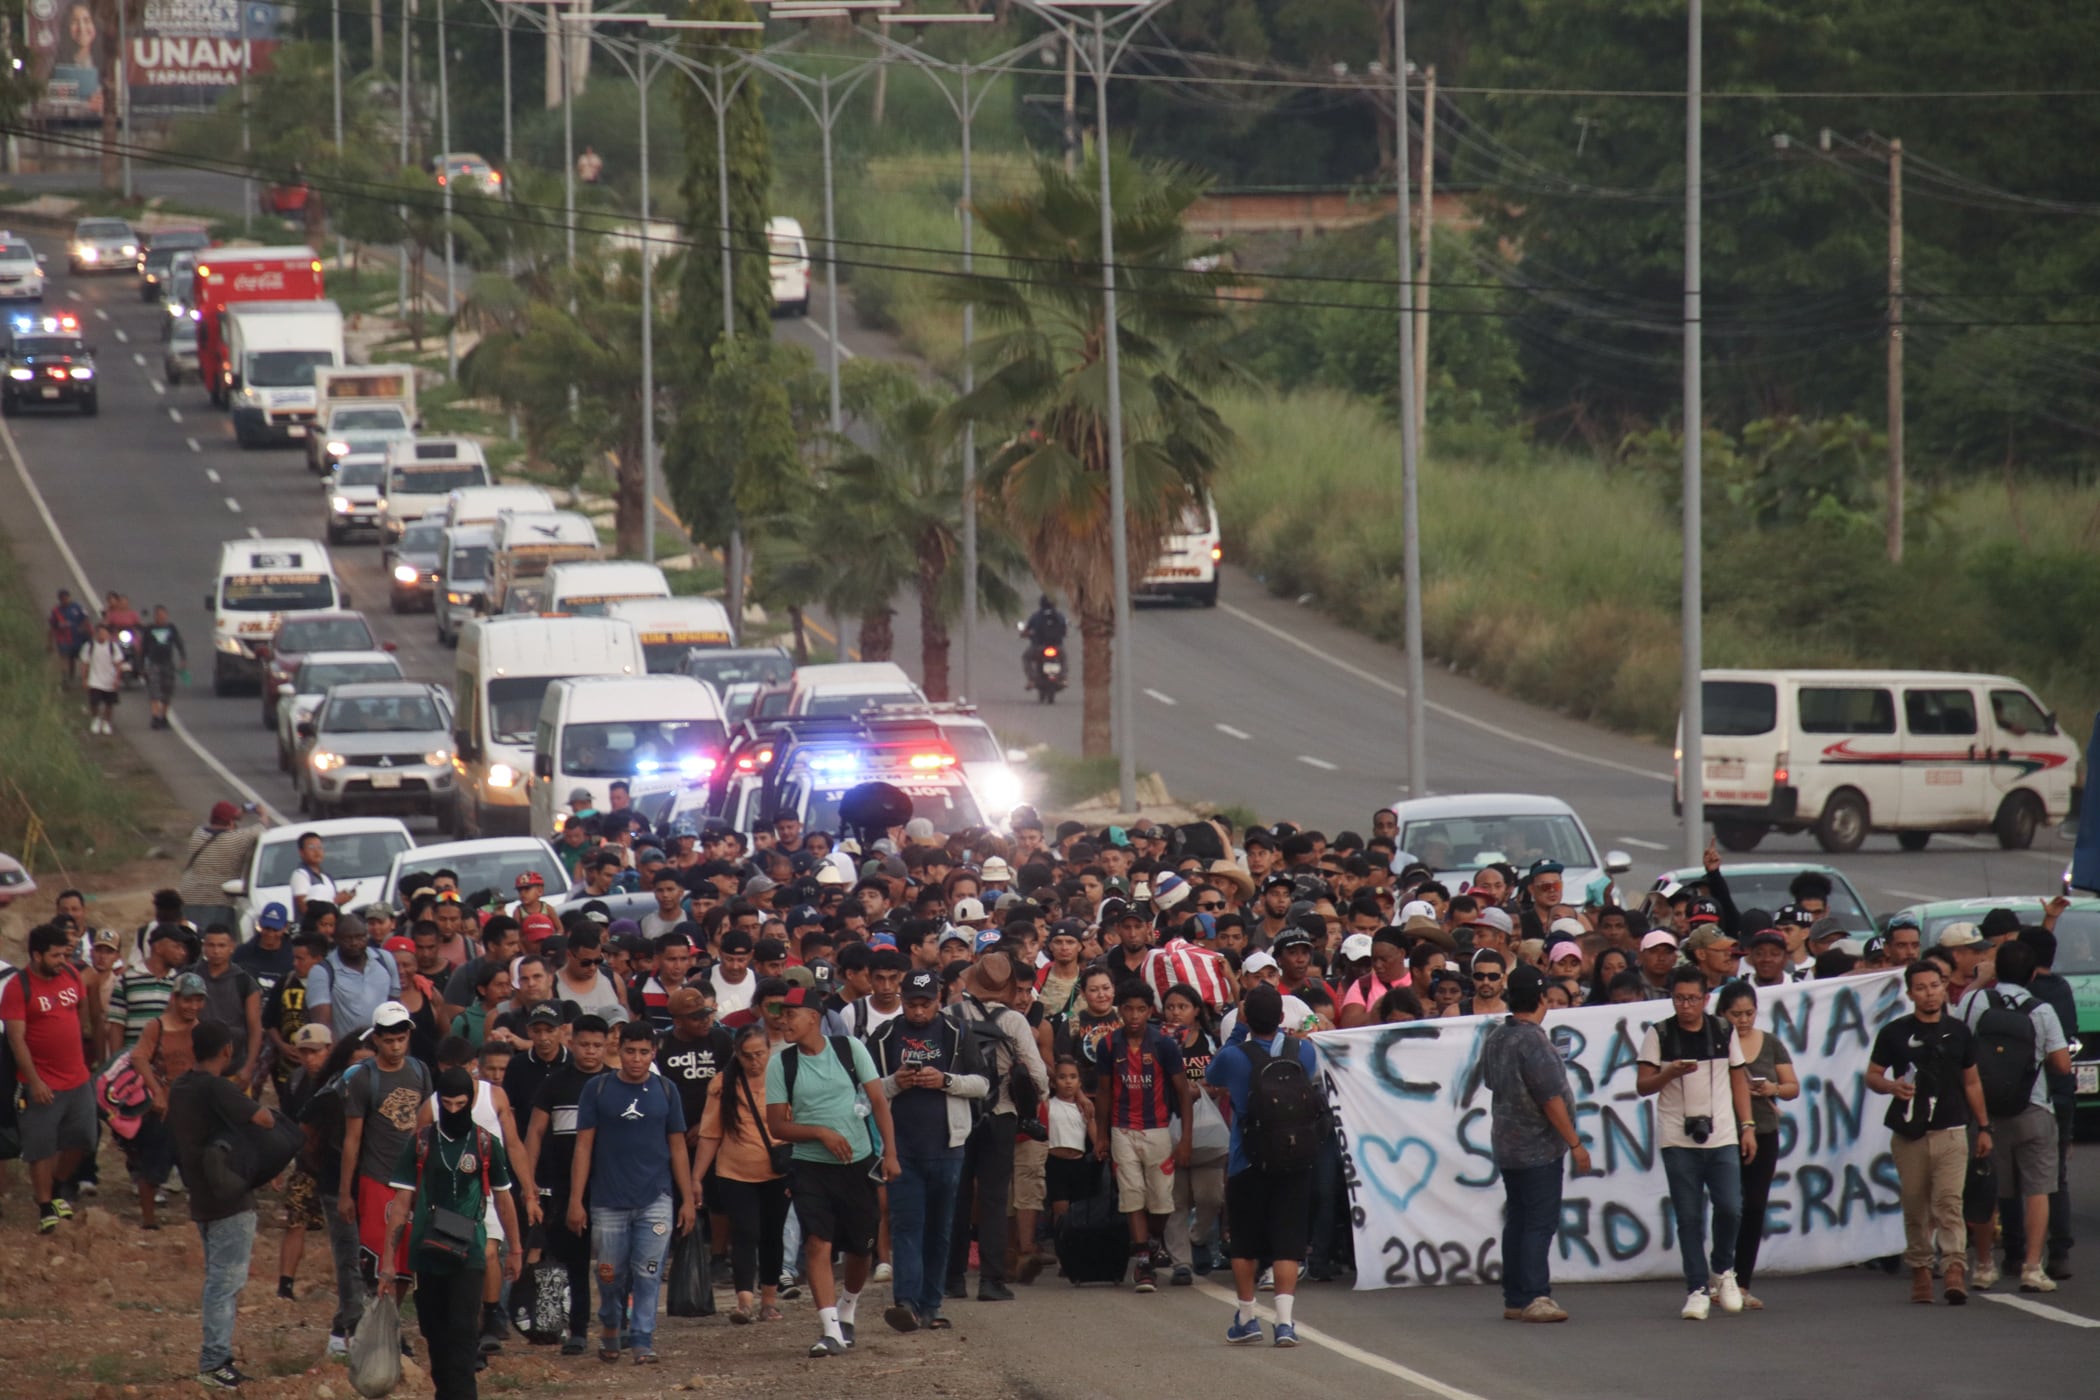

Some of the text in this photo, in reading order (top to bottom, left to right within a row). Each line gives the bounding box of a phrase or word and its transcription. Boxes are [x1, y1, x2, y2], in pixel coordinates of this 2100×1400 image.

[133, 38, 252, 69] UNAM
[146, 70, 237, 86] TAPACHULA
[1382, 1236, 1502, 1286] 2026
